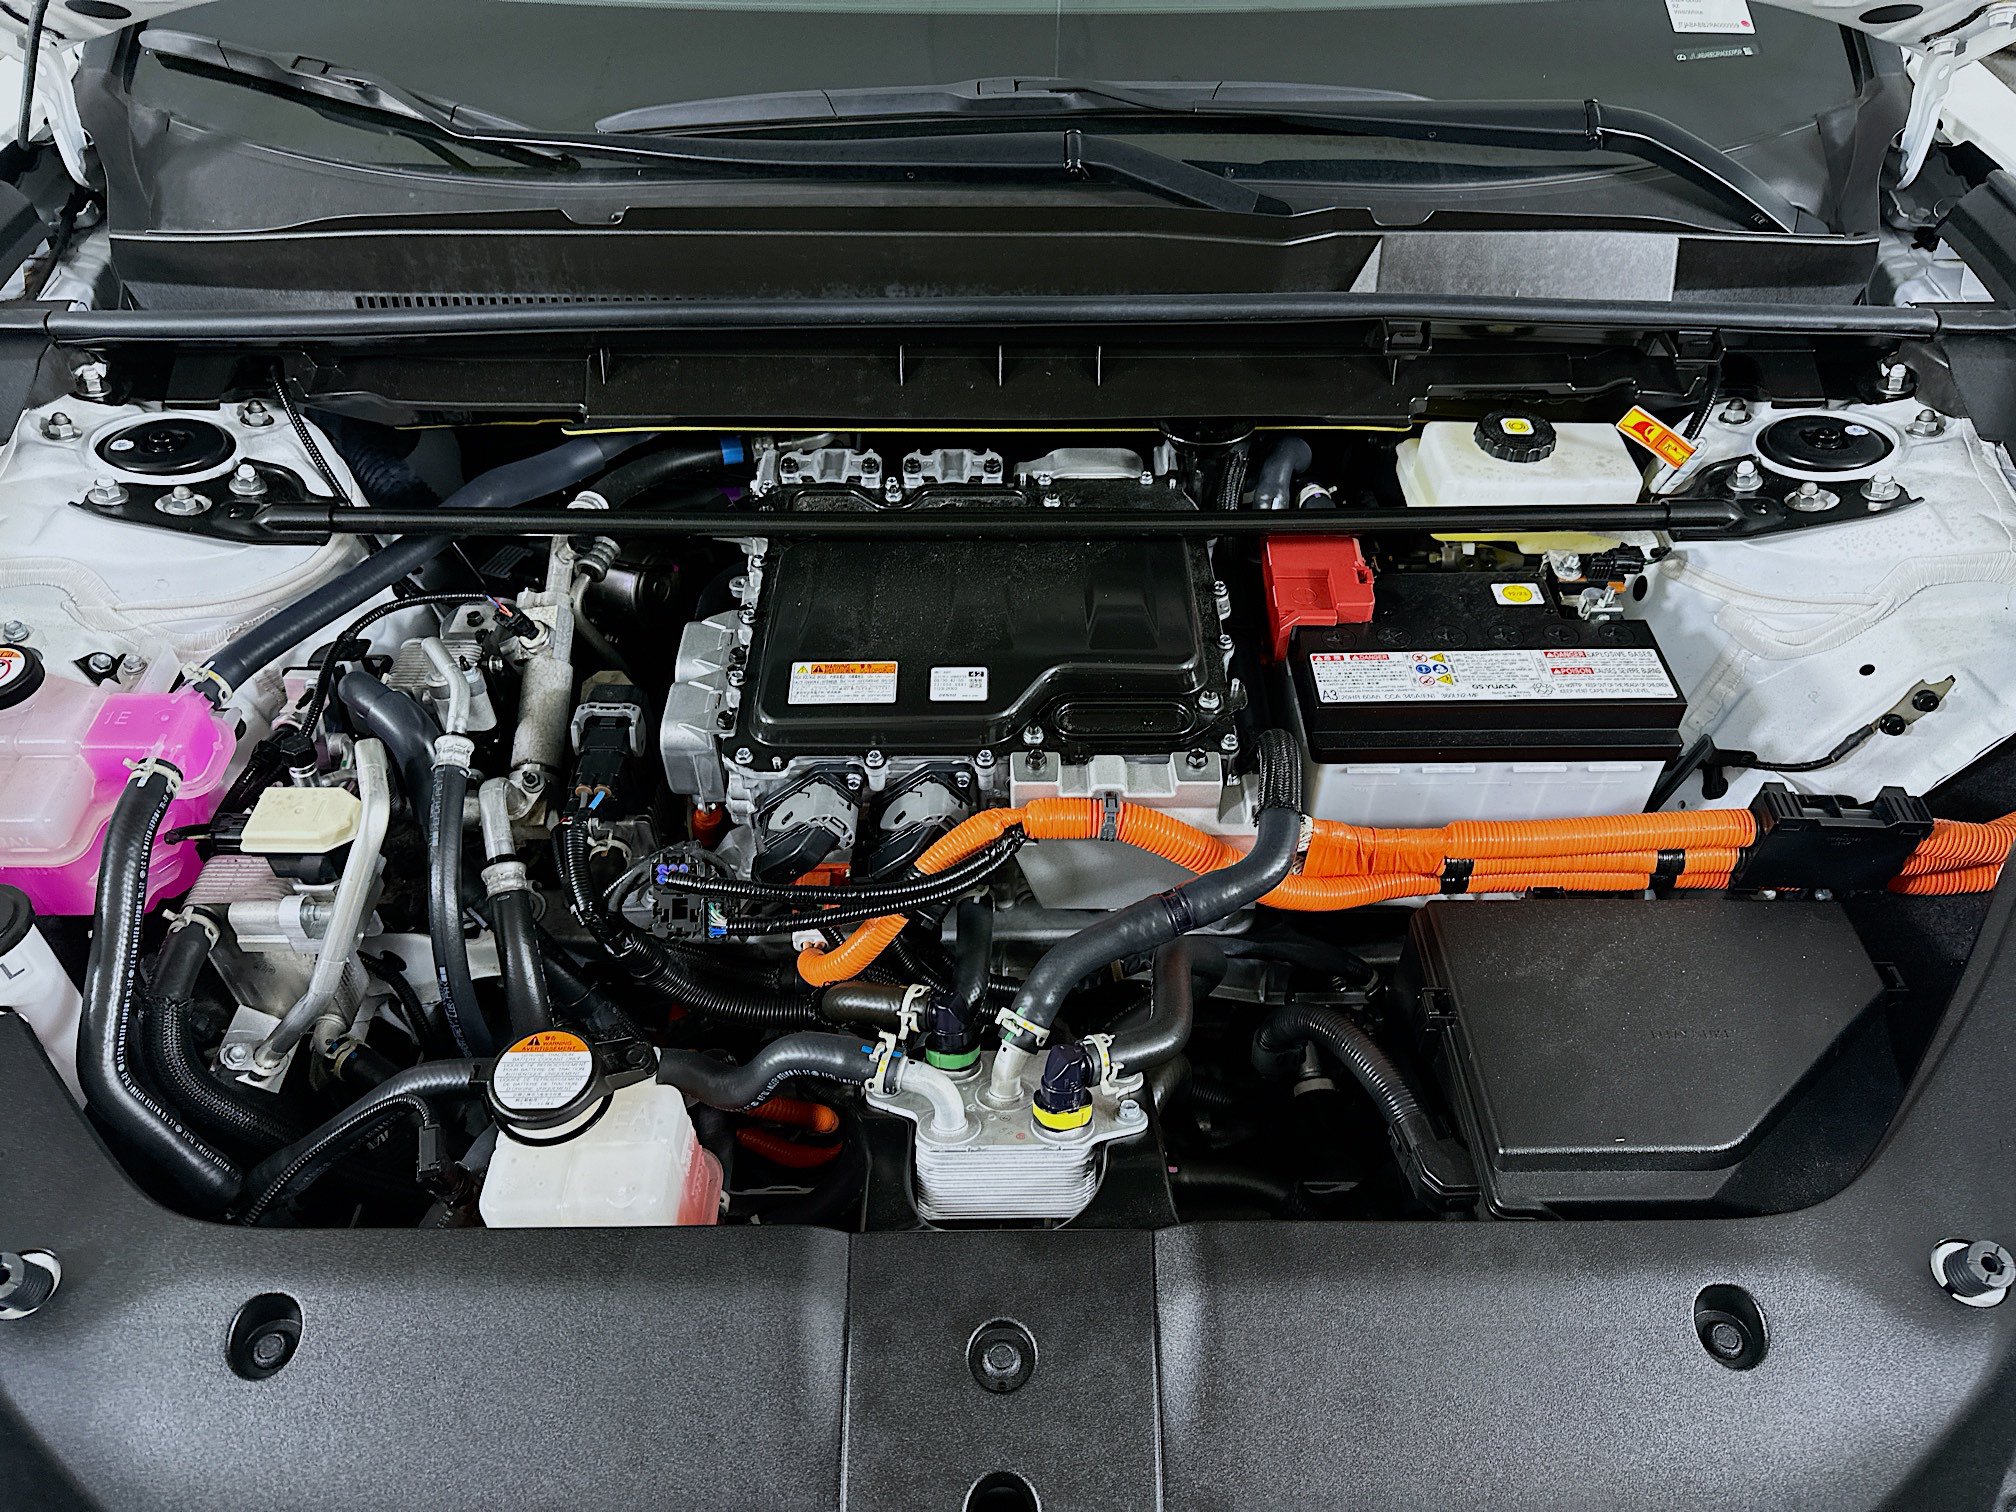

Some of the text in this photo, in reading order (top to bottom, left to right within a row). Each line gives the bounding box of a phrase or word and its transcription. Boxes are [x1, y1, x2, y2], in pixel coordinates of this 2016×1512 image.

[1323, 690, 1338, 700] A3
[143, 830, 152, 850] WATER
[118, 1025, 126, 1046] WATER
